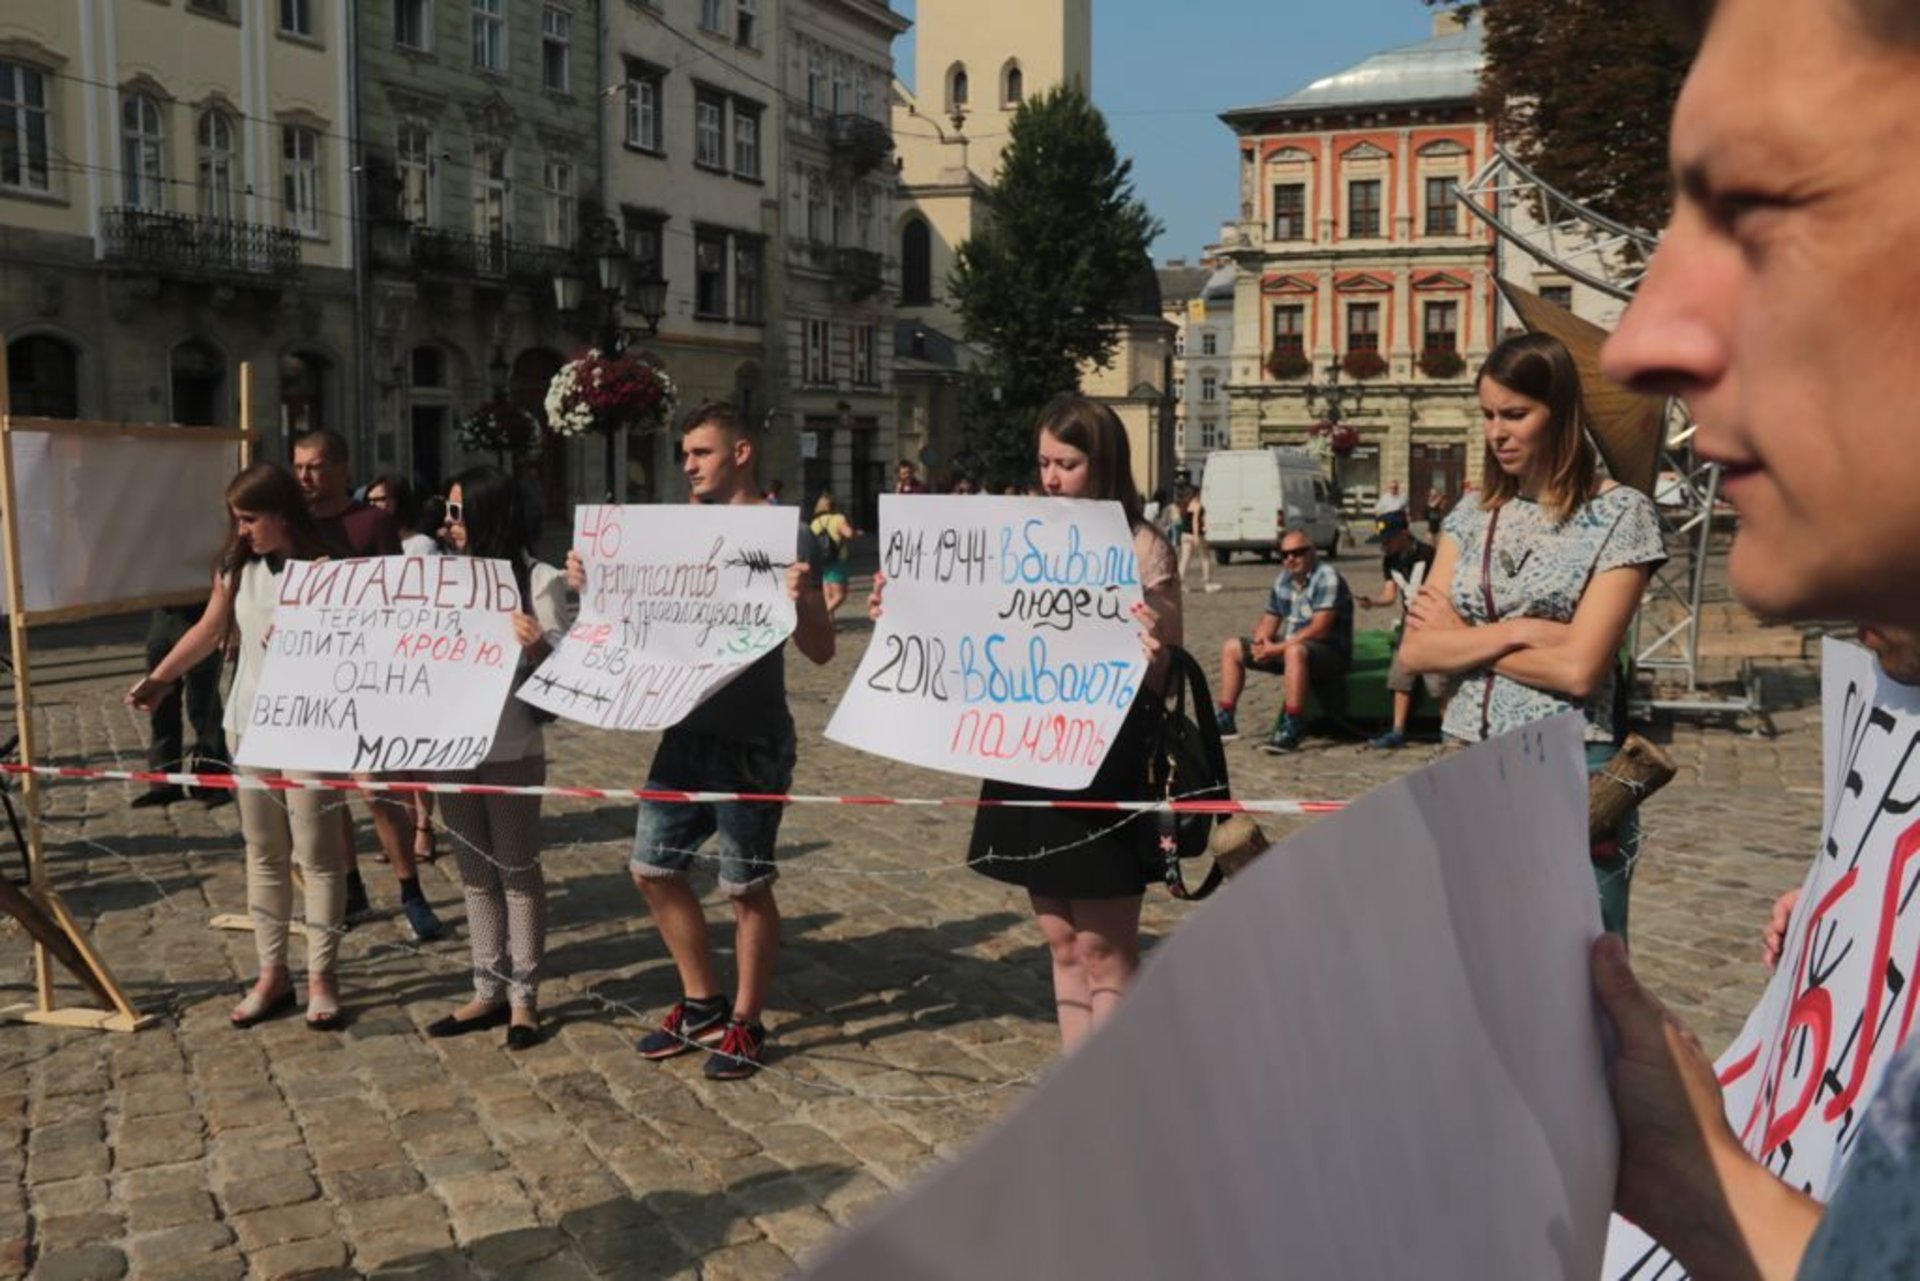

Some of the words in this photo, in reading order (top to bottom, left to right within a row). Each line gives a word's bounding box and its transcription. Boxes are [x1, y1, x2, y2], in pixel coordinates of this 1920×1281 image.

[581, 505, 624, 558] 46
[280, 556, 518, 613] ЦИТАДЕЛЬ
[998, 585, 1129, 631] людей
[582, 644, 628, 675] БУВ
[333, 661, 431, 696] ОДНА
[253, 694, 358, 731] ВЕЛИКА
[351, 734, 488, 769] МОГИЛА
